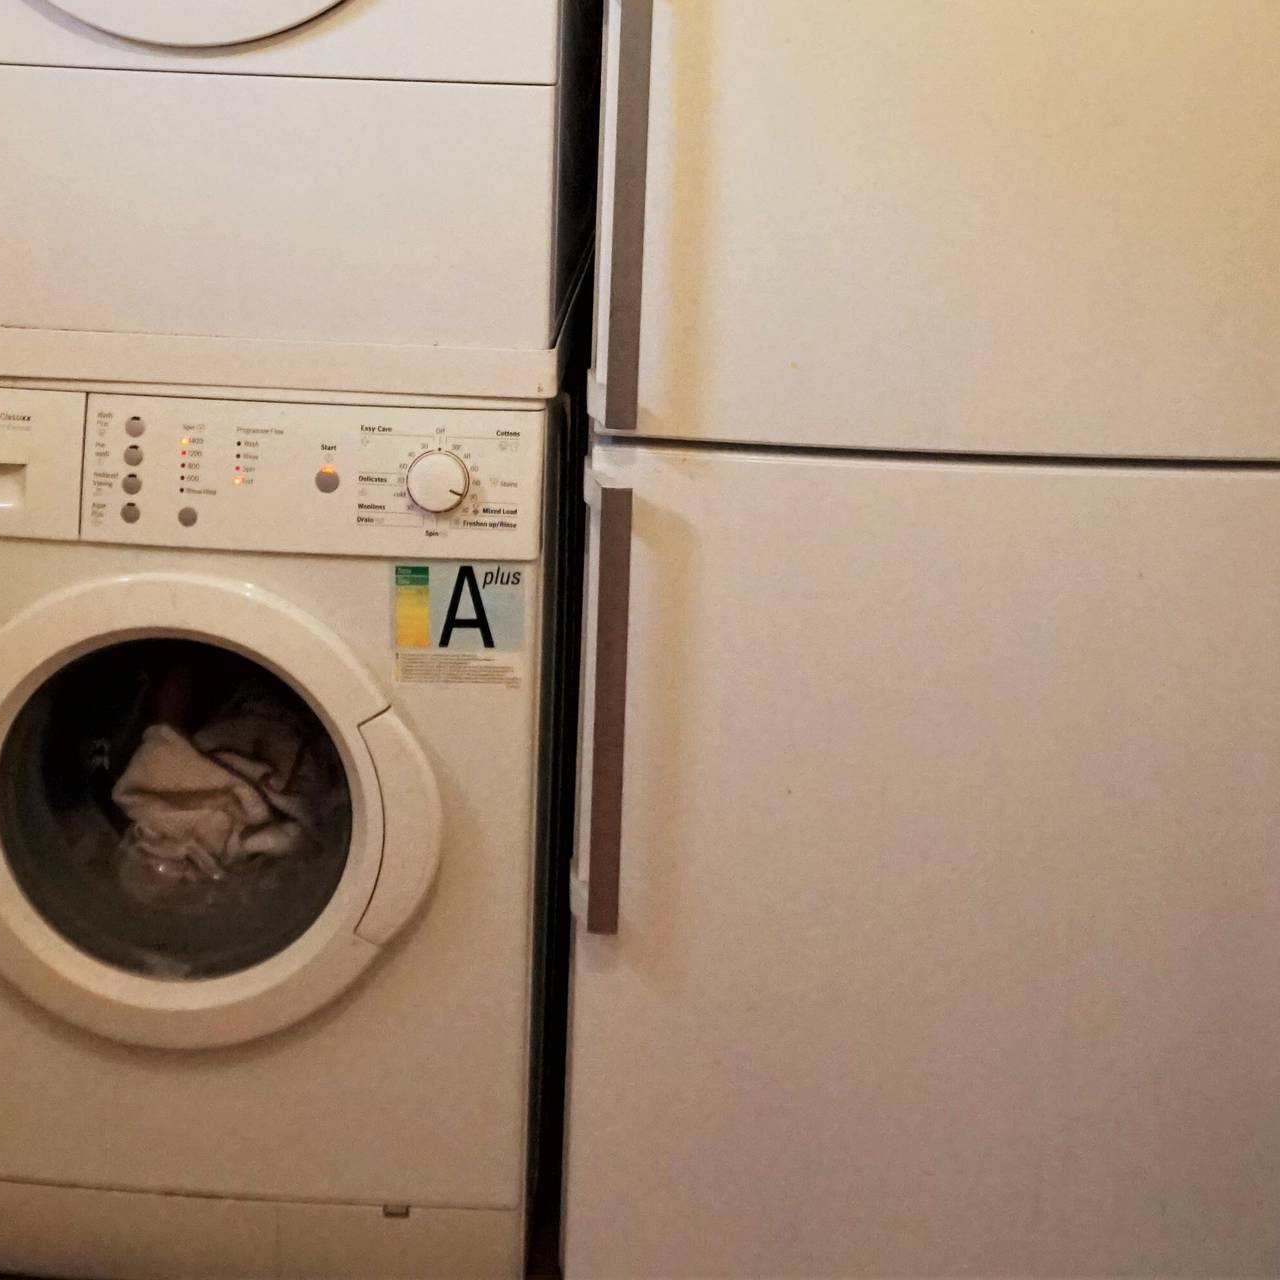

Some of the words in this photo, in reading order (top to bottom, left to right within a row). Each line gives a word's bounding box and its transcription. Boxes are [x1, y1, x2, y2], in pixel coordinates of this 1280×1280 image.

[360, 425, 376, 433] Easy
[359, 475, 387, 483] Delicates
[438, 566, 495, 648] A
[482, 566, 521, 590] plus
